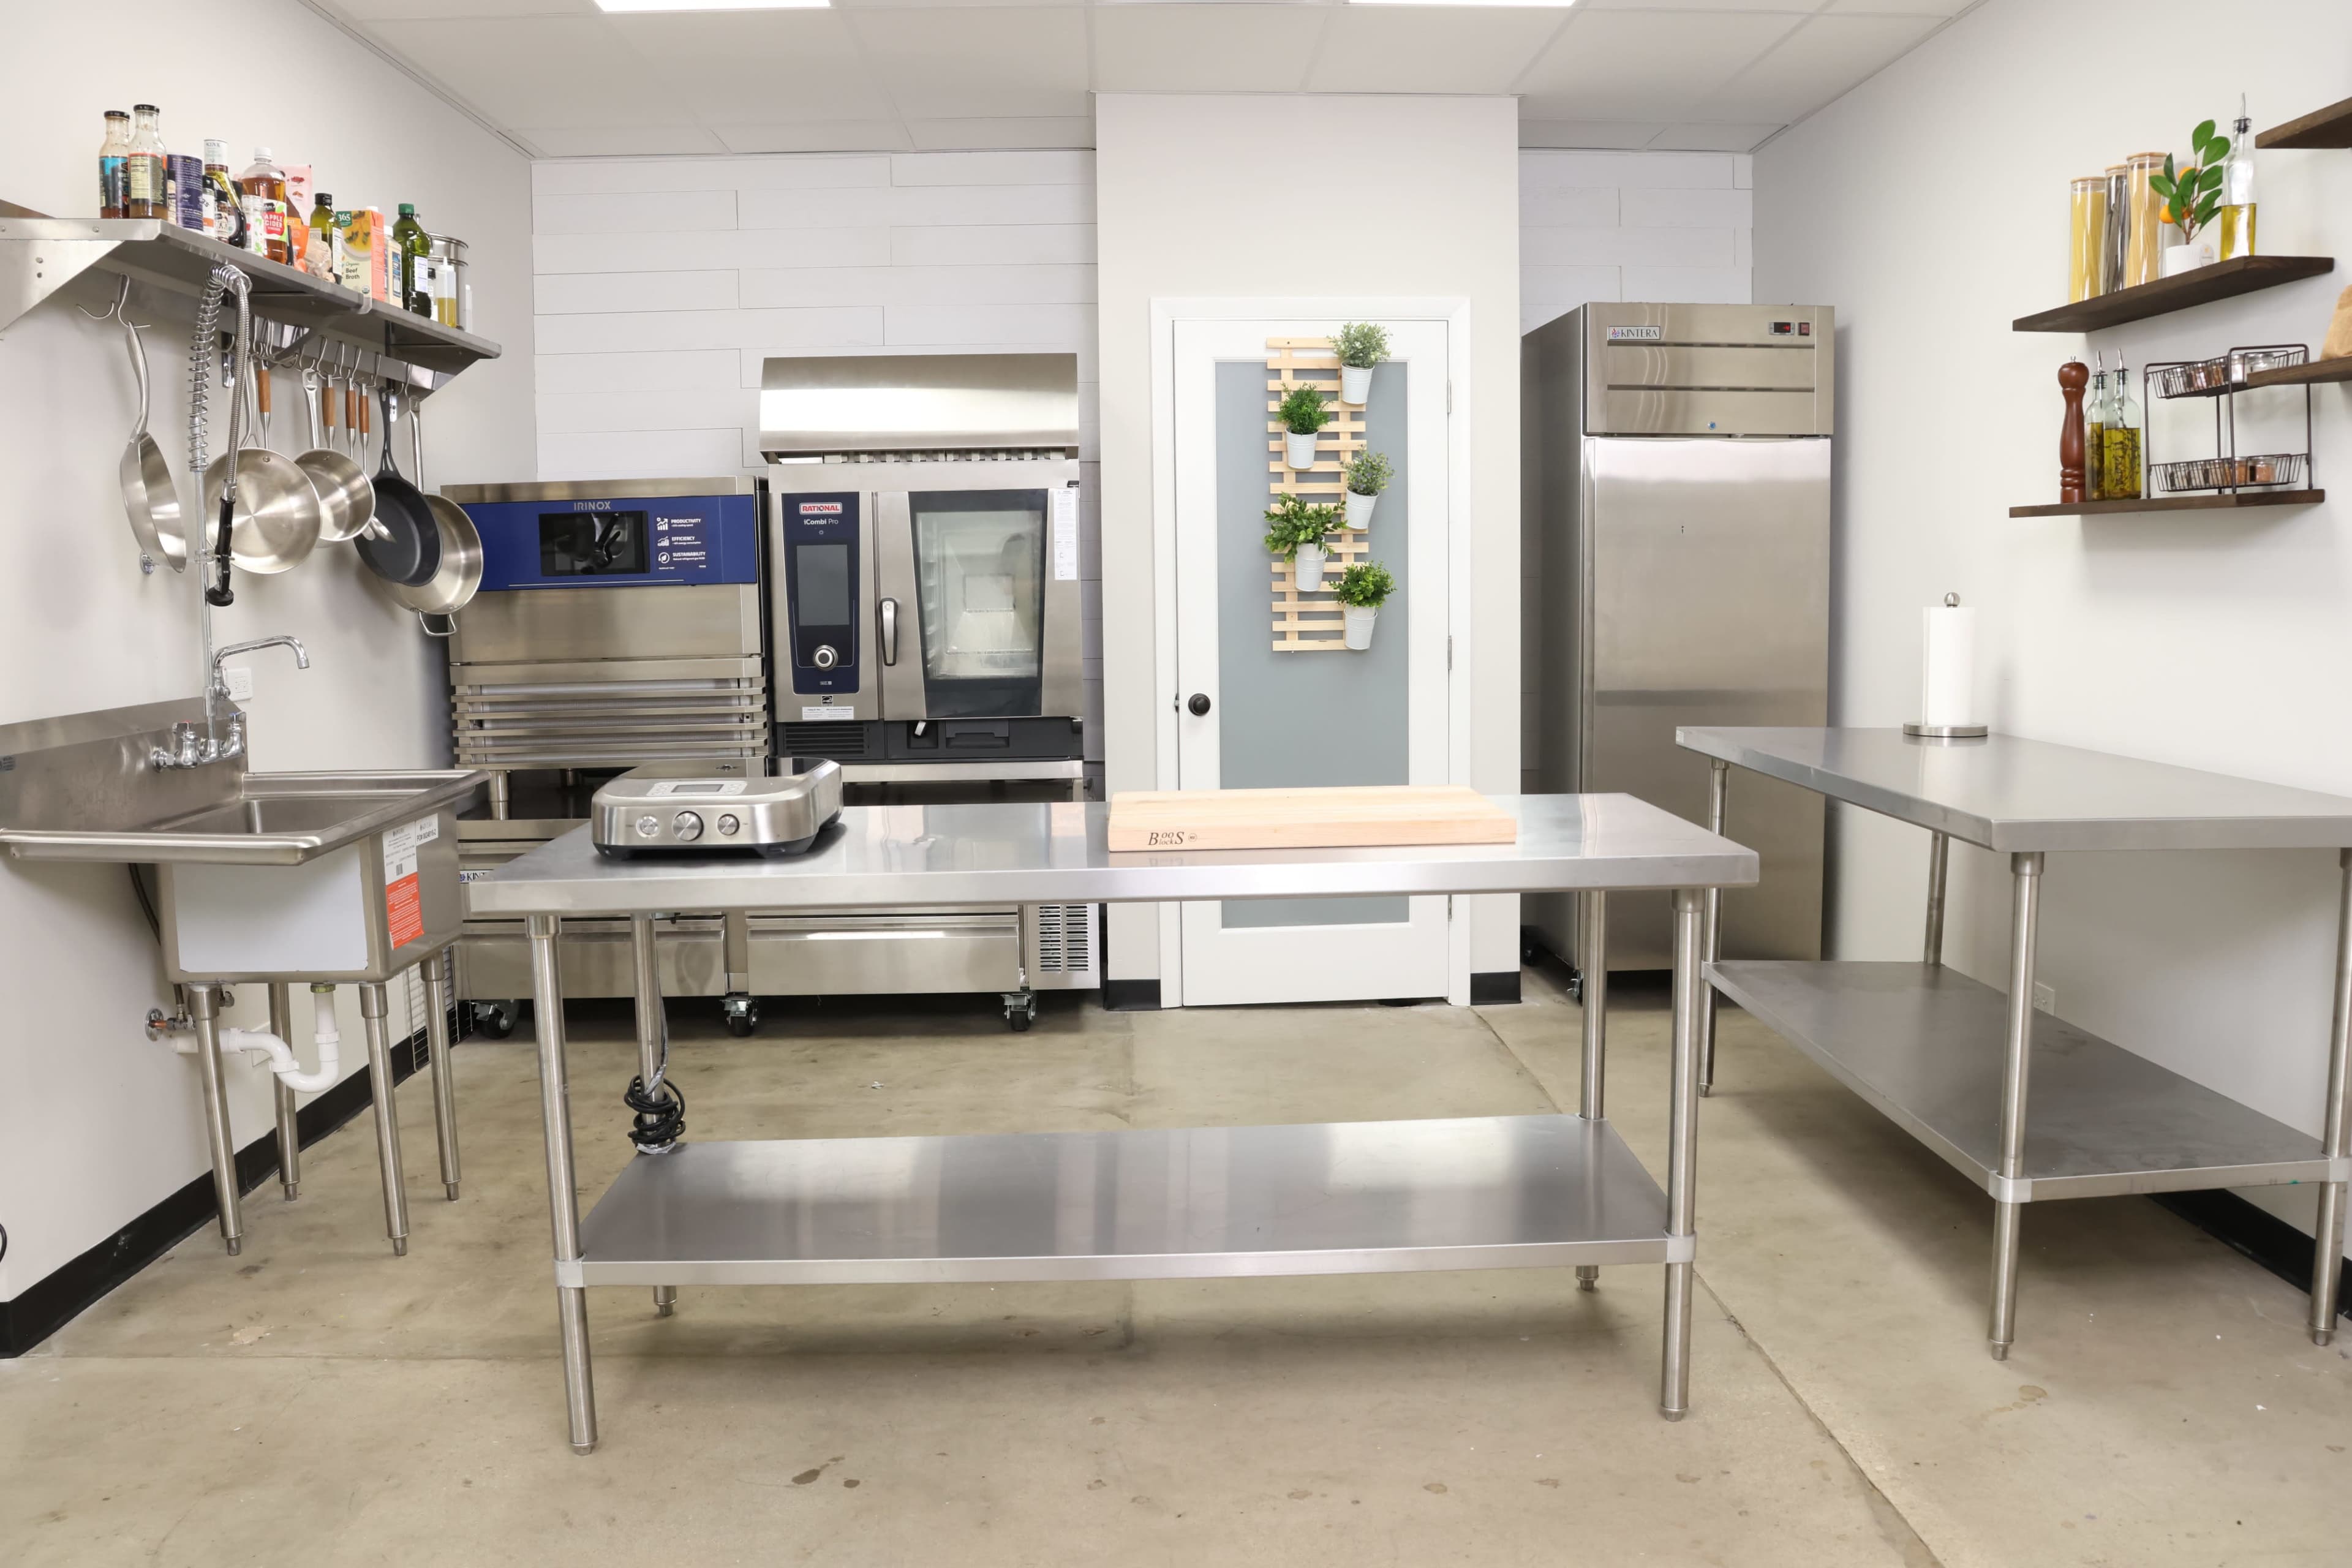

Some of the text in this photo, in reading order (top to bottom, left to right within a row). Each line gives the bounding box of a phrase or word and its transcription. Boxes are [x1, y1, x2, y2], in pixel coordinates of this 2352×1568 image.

[338, 213, 351, 221] 365
[1621, 329, 1657, 337] KINTERA
[574, 501, 611, 510] IRINOX
